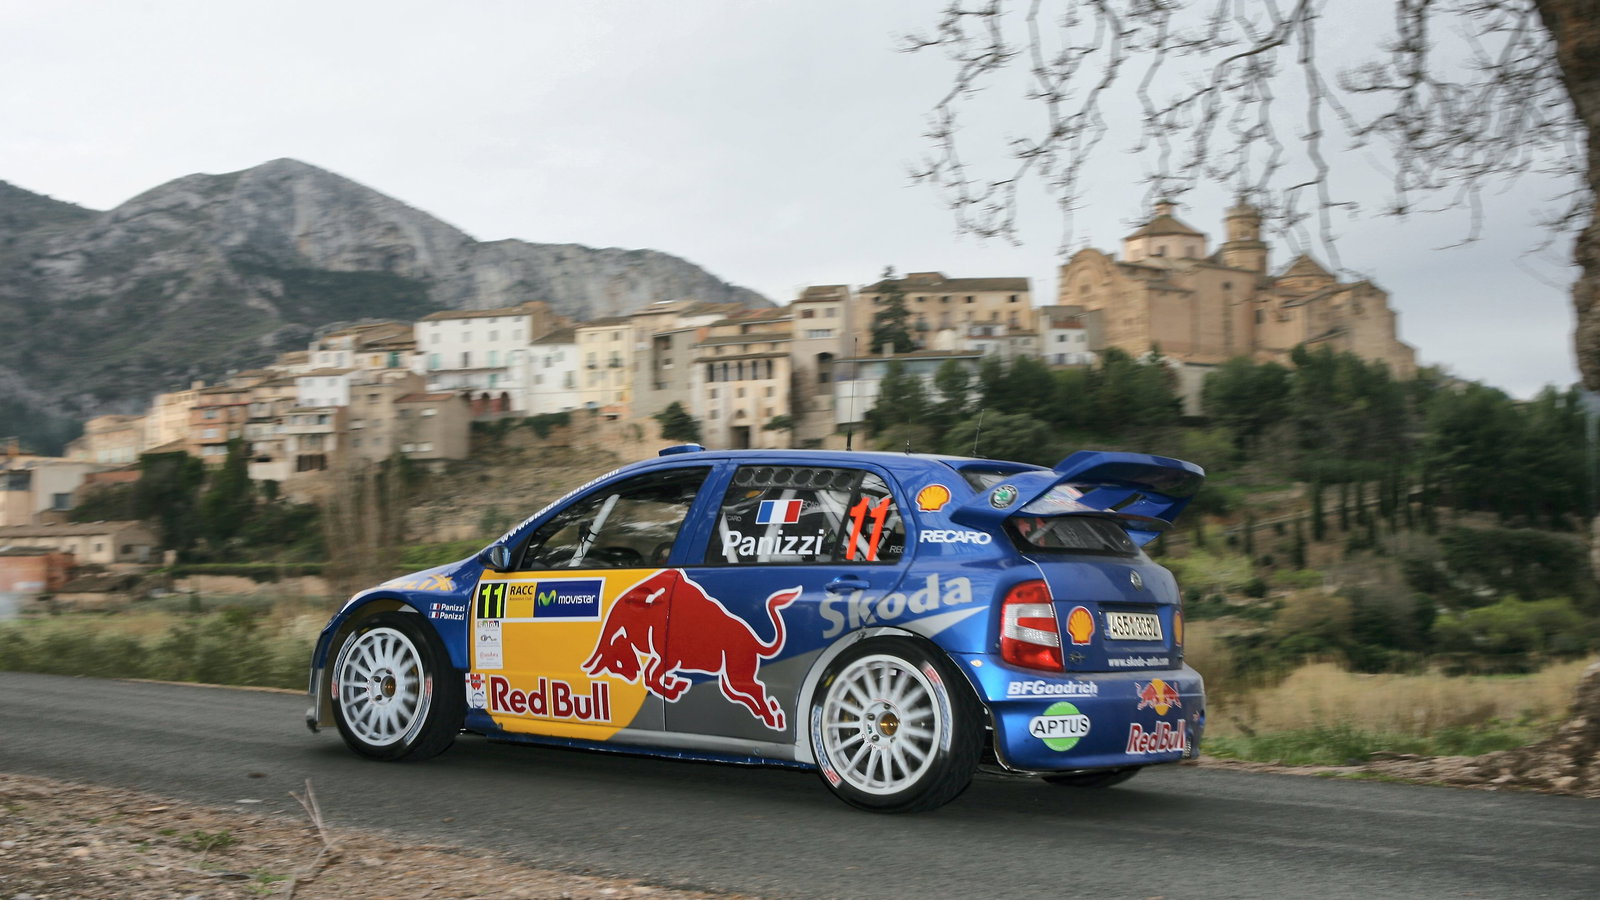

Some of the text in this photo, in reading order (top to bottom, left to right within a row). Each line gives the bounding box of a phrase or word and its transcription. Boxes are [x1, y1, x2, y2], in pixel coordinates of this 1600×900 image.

[845, 497, 891, 561] 11
[919, 530, 992, 545] RECARO
[722, 529, 824, 556] Panizzi
[510, 585, 534, 596] RACC
[441, 603, 466, 612] Panizzi
[482, 584, 504, 618] 11
[558, 594, 596, 605] movistar
[819, 573, 973, 639] Škoda
[440, 612, 465, 621] Panizzi
[1007, 680, 1099, 696] BFGoodrich
[490, 676, 611, 721] Red Bull
[1033, 717, 1088, 734] APTUS
[1126, 721, 1160, 754] Red
[1158, 719, 1185, 752] Bull
